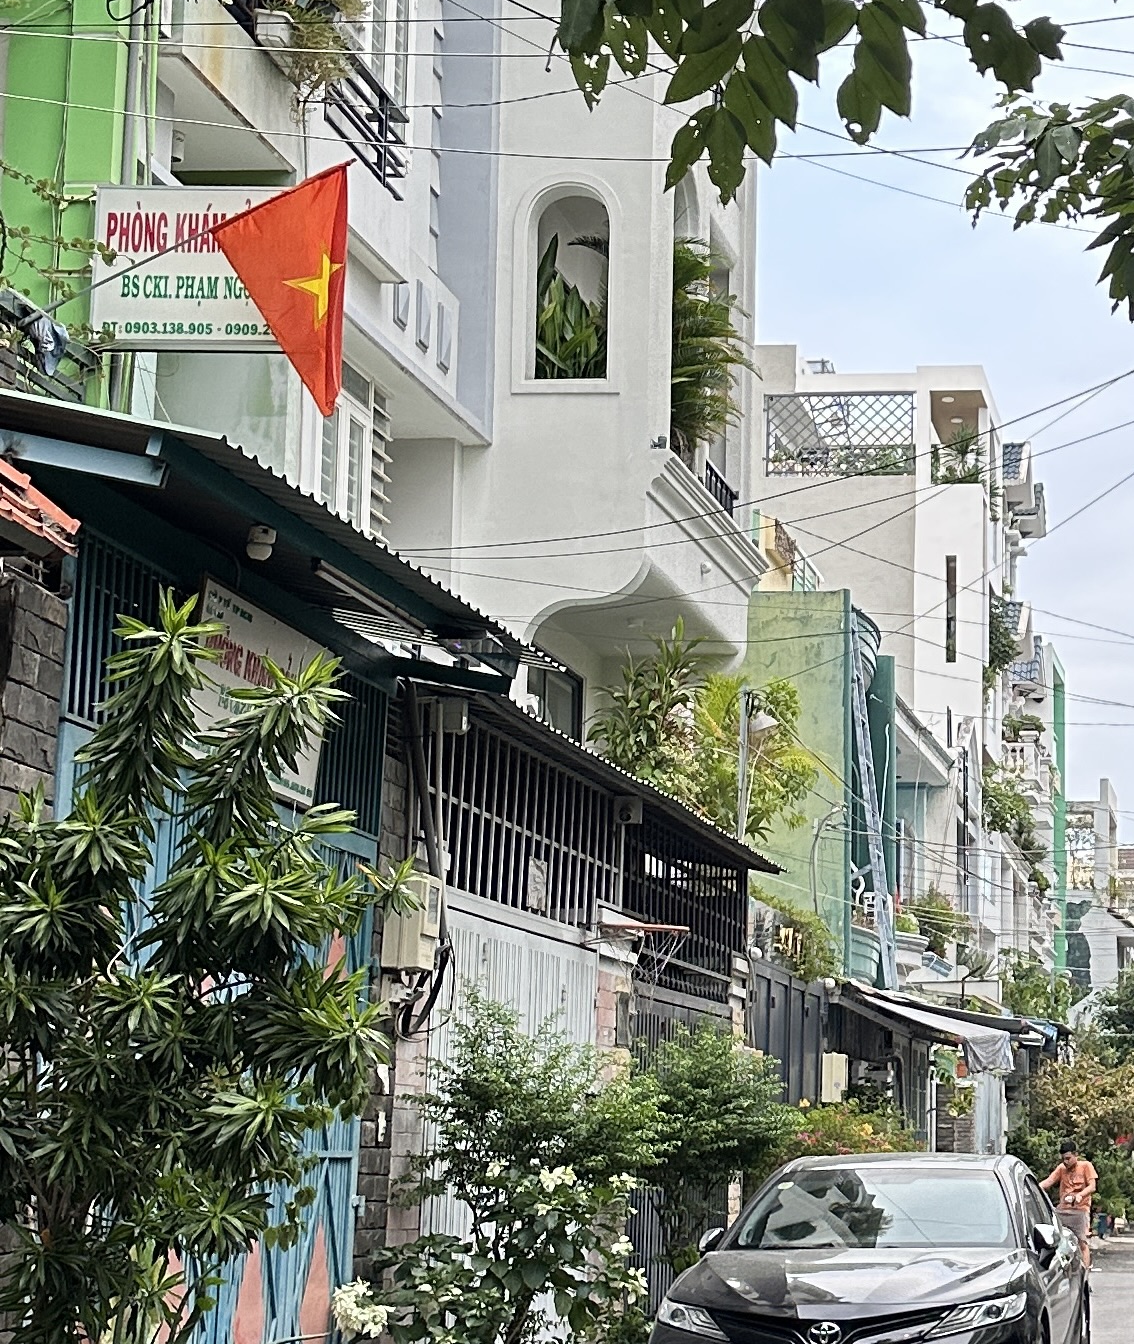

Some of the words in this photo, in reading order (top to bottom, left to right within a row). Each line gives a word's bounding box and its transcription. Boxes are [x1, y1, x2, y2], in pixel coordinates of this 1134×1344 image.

[107, 201, 168, 253] PHÒNG
[121, 275, 140, 298] BS
[144, 275, 172, 299] CKI.
[175, 276, 219, 306] PHẠM
[125, 321, 213, 335] 0903.138.905
[225, 323, 275, 336] 0909.2
